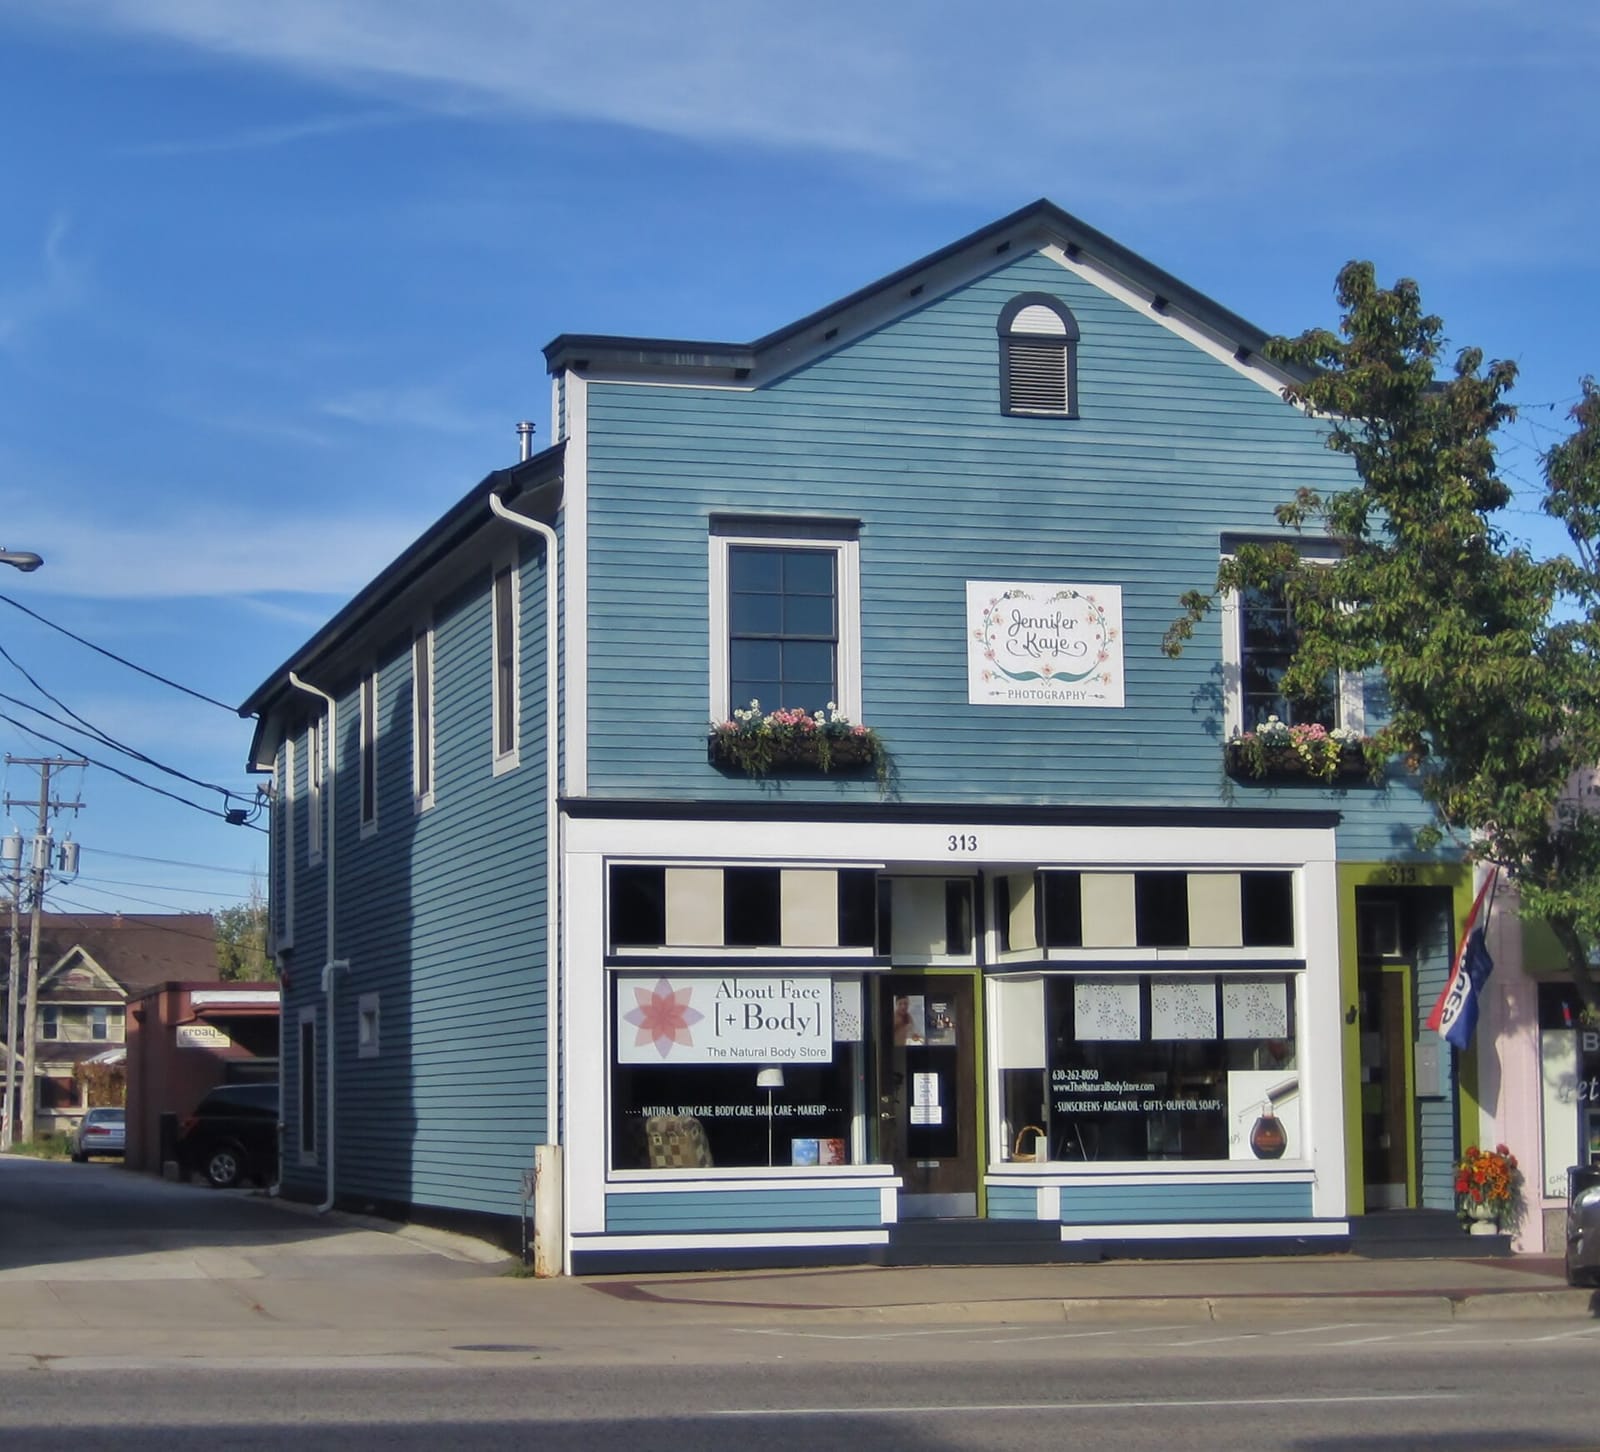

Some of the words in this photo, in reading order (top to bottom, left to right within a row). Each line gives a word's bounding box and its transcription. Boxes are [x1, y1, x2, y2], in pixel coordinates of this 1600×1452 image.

[1008, 609, 1079, 637] Jennifer
[1006, 631, 1088, 658] Kaye
[1008, 689, 1088, 700] PHOTOGRAPHY
[947, 834, 978, 851] 313
[1388, 866, 1416, 883] 313
[715, 978, 775, 999] About
[780, 979, 821, 999] Face
[706, 1047, 727, 1057] The
[730, 1047, 768, 1057] Natural
[770, 1047, 797, 1059] Body
[799, 1047, 827, 1057] Store
[1052, 1069, 1099, 1080] 630-262-8050
[1052, 1080, 1155, 1095] www.TheNaturalBodyStore.com
[642, 1106, 675, 1117] NATURAL
[797, 1105, 827, 1116] MAKEUP
[1057, 1100, 1100, 1112] SUNSCREENS
[1103, 1100, 1127, 1111] ARGAN
[1127, 1100, 1139, 1111] OIL
[1143, 1100, 1163, 1111] GIFTS
[1166, 1100, 1186, 1111] OLIVE
[1186, 1100, 1198, 1111] OIL
[1199, 1100, 1220, 1111] SOAPS
